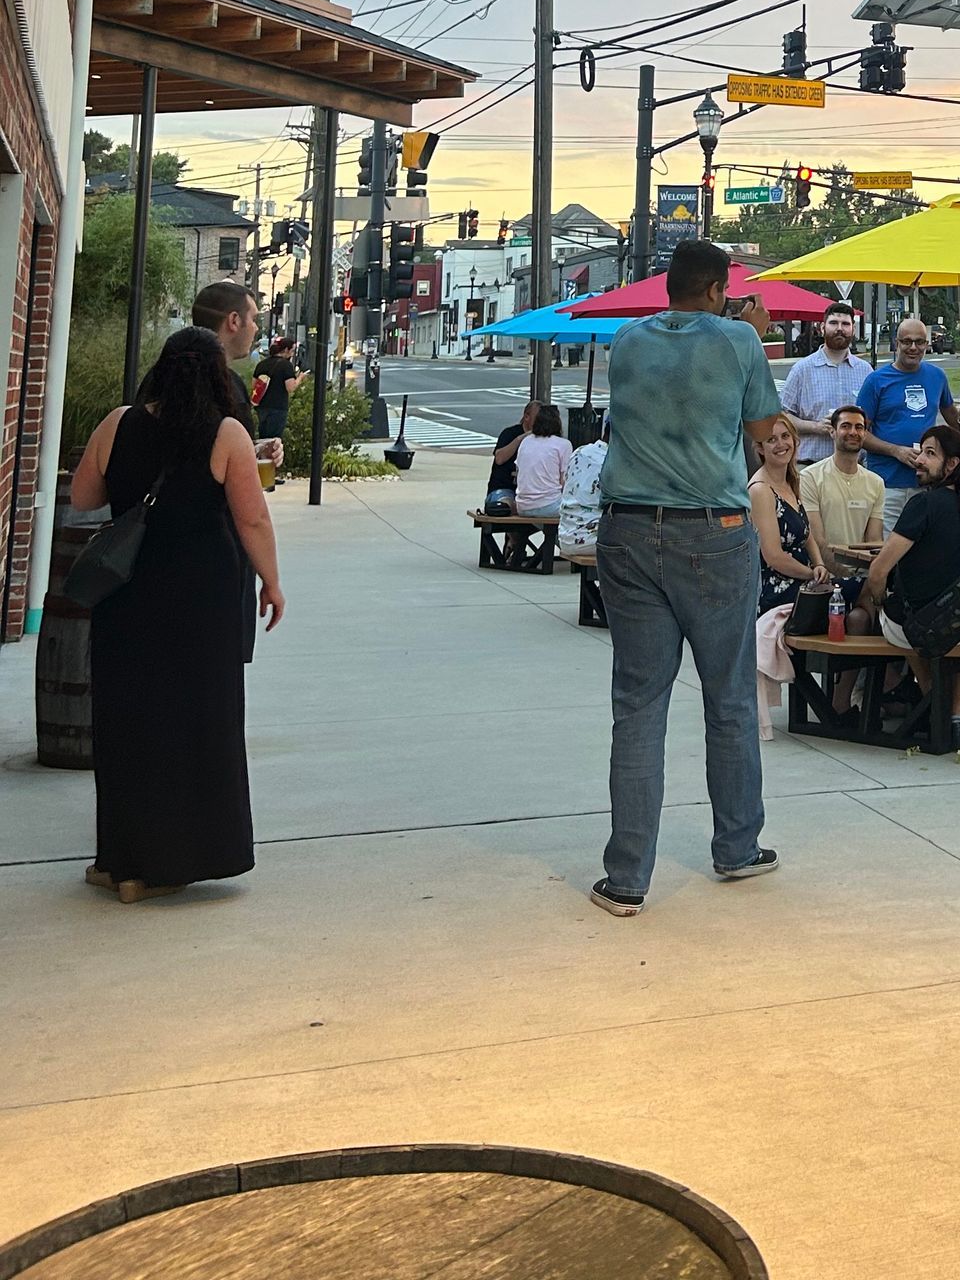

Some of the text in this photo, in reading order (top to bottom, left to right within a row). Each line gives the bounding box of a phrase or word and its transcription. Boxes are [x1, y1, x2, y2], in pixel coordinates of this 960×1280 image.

[729, 81, 823, 101] OPPOSING TRAFFIC HAS EXTENDED GREEN
[660, 190, 697, 201] WELCOME
[732, 190, 759, 201] Atlantic
[659, 222, 697, 230] BARRINGTON
